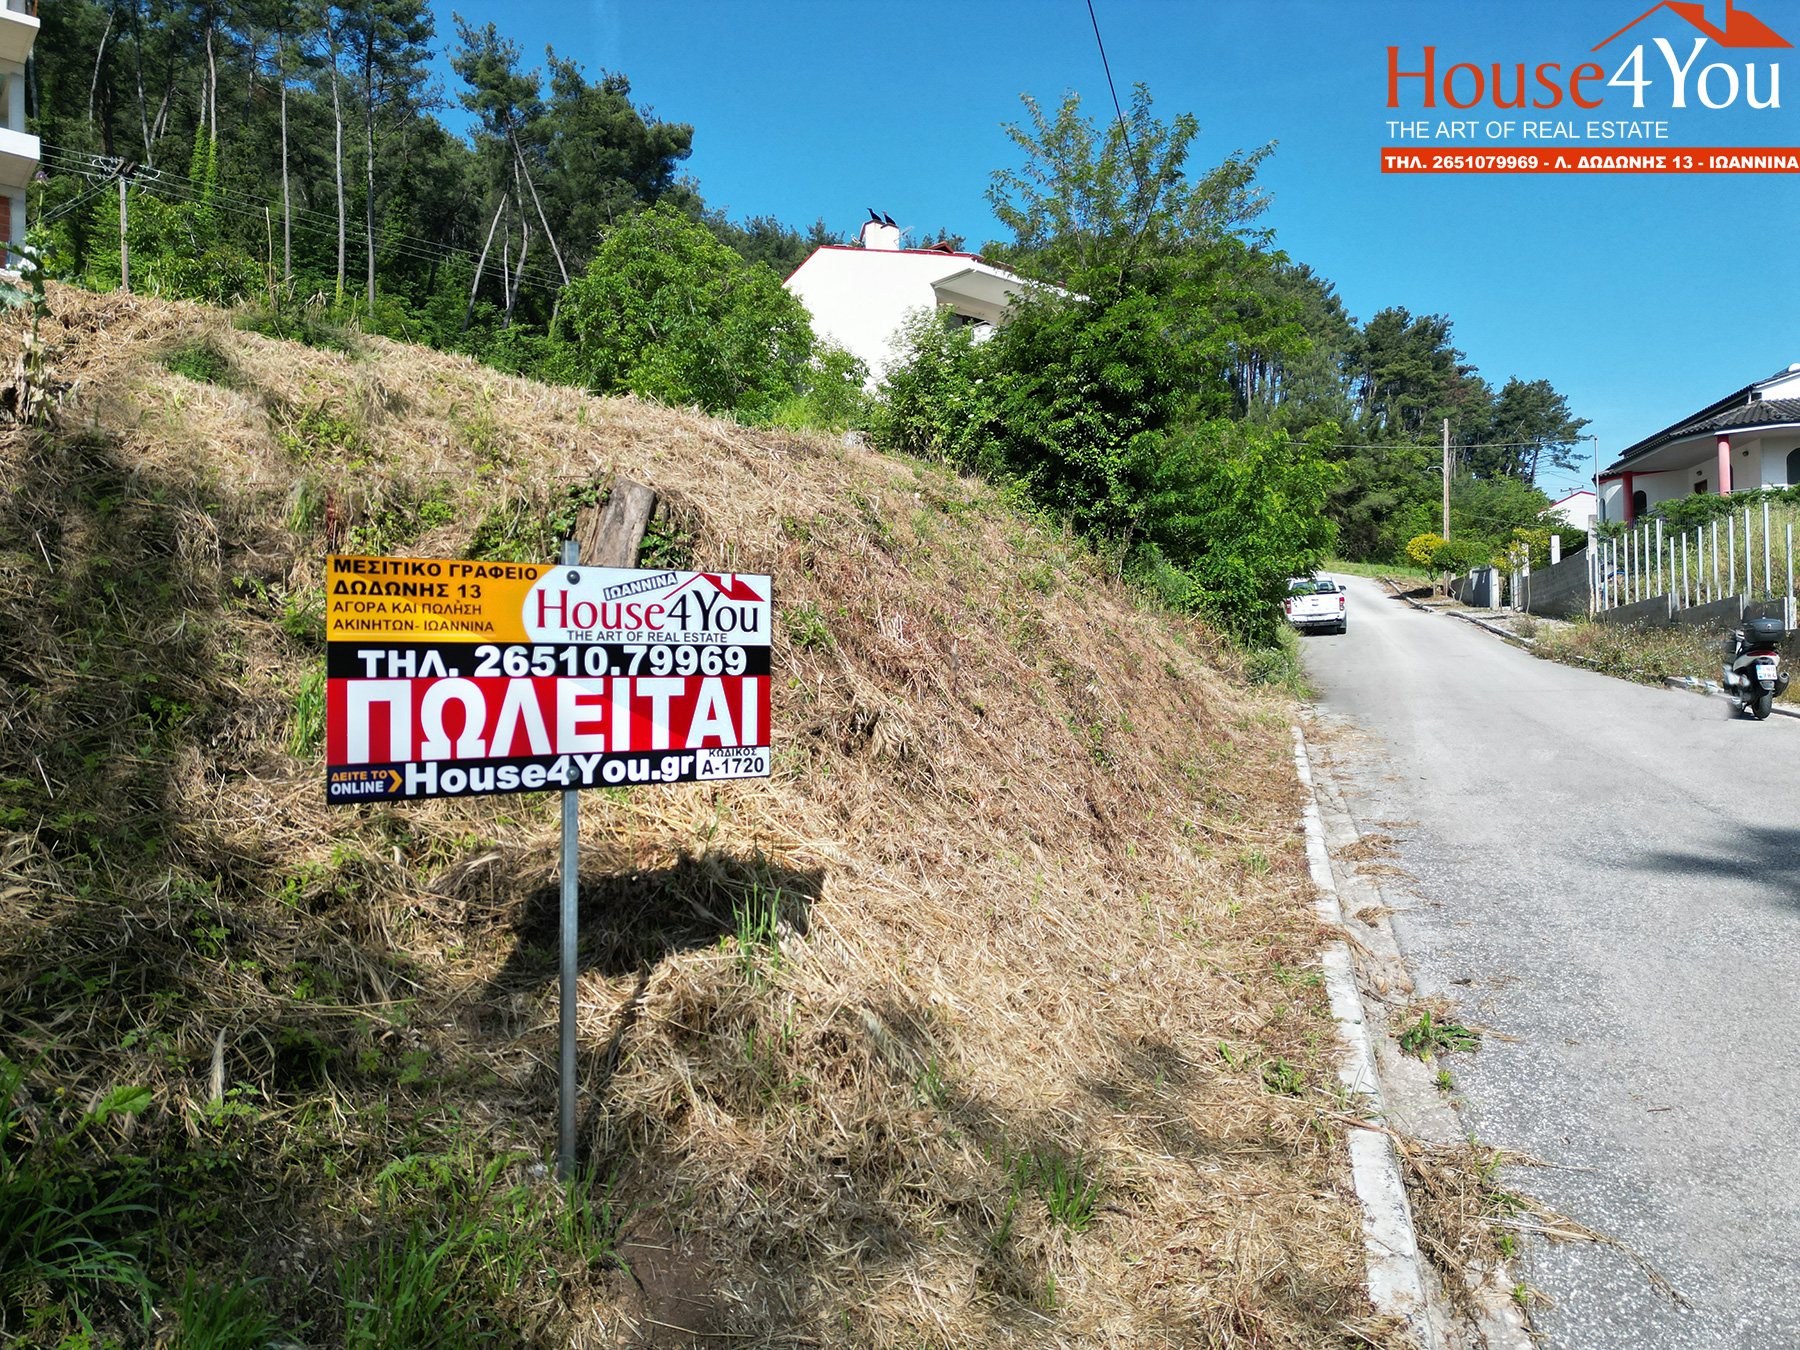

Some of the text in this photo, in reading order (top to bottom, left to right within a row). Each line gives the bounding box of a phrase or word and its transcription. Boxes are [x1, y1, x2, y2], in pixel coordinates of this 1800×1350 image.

[333, 559, 538, 581] ΜΕΣΙΤΙΚΟ ΓΡΑΦΕΙΟ
[333, 580, 482, 599] ΔΩΔΩΝΗΣ 13
[604, 573, 678, 600] ΙΩΑΝΝΙΝΑ
[333, 601, 387, 613] ΑΓΟΡΑ
[392, 603, 417, 614] ΚΑΙ
[536, 589, 759, 632] House4You
[424, 620, 494, 632] ΙΩΑΝΝΙΝΑ
[567, 630, 727, 643] THE ART OF REAL ESTATE
[357, 645, 748, 679] ΤΗΛ. 26510.79969
[347, 676, 758, 764] ΠΩΛΕΙΤΑΙ
[708, 748, 757, 757] ΚΩΔΙΚΟΣ
[331, 770, 388, 782] ΔΕΙΤΕ ΤΟ
[405, 753, 695, 796] House4You.gr
[331, 781, 384, 795] ONLINE
